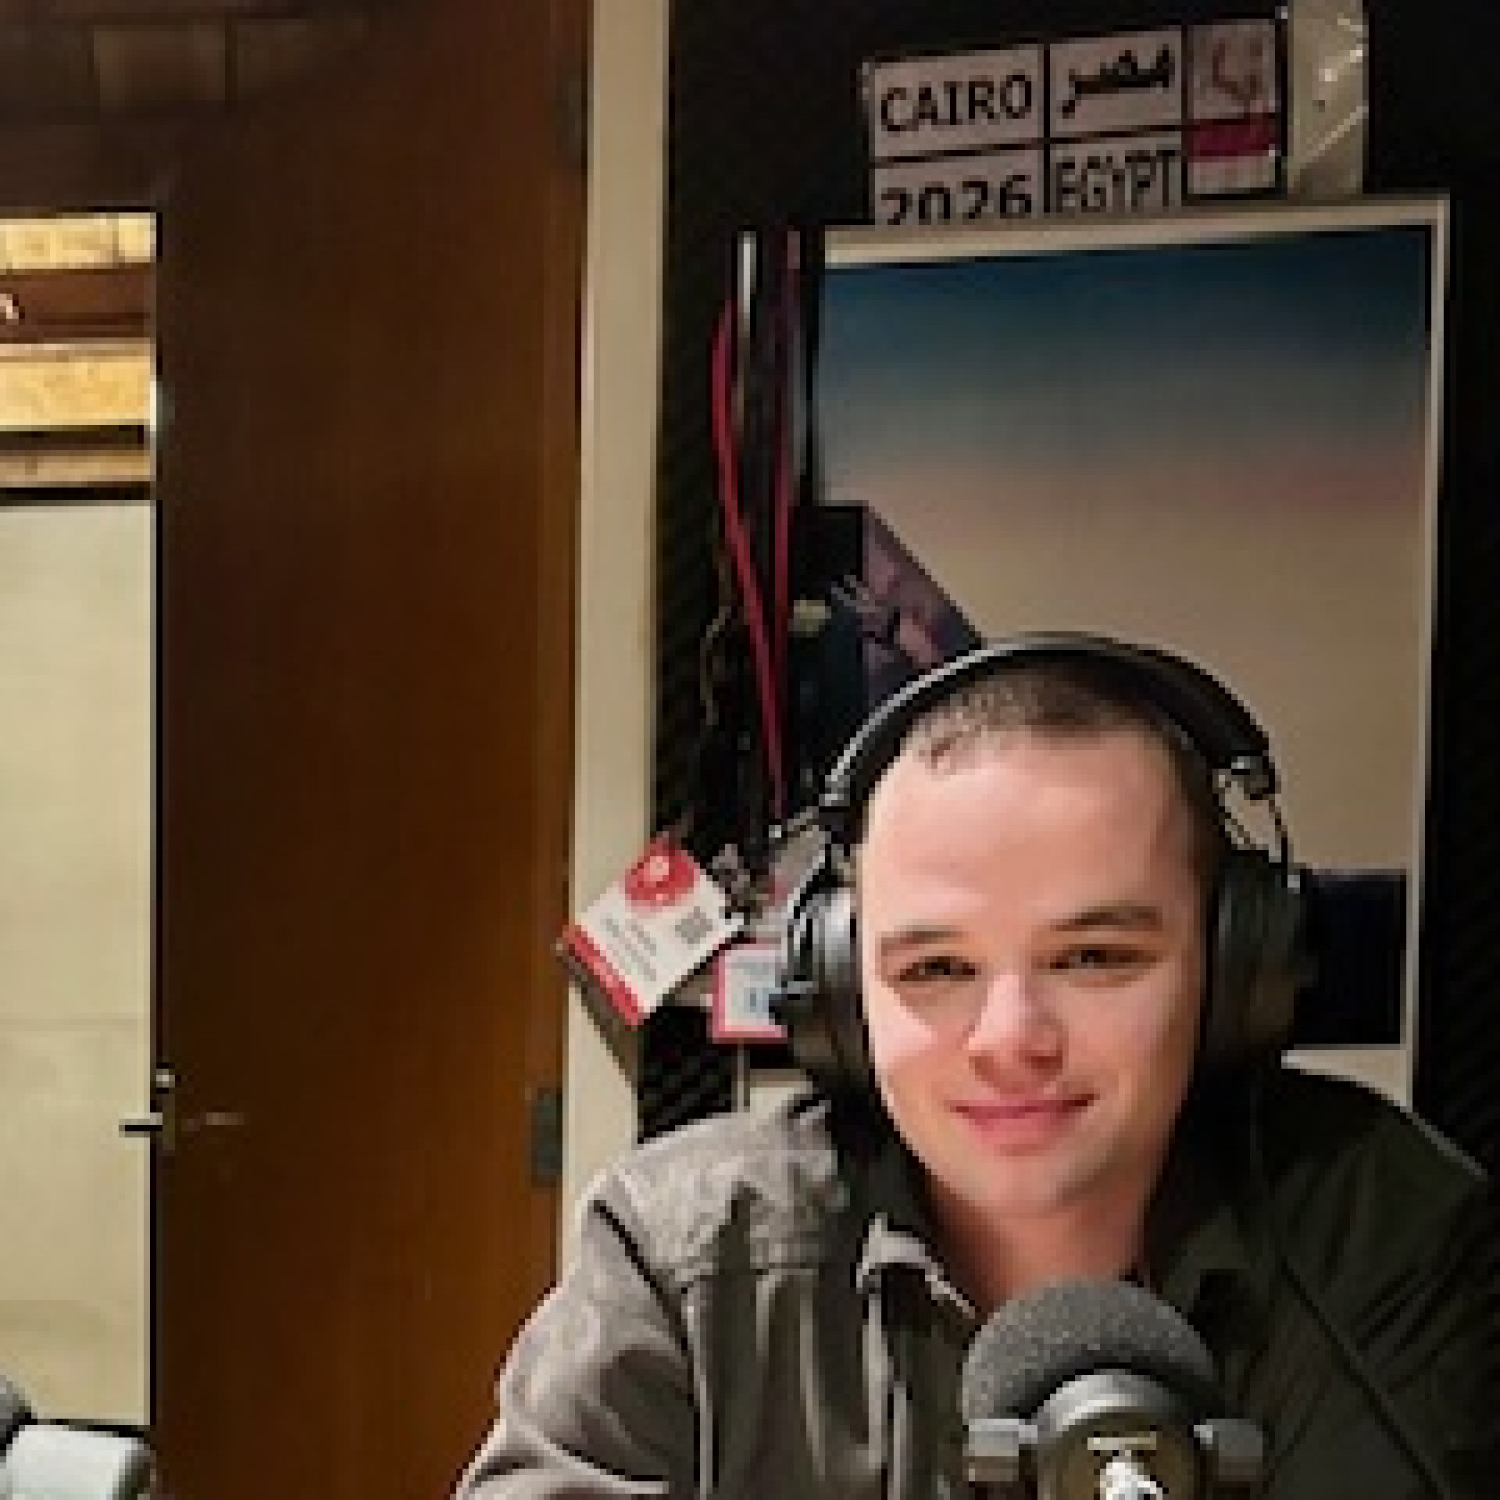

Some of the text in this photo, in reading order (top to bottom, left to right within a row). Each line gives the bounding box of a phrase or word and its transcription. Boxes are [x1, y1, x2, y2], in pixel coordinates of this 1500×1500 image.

[880, 74, 1033, 133] CAIRO
[1062, 46, 1176, 119] مصر
[879, 174, 1034, 226] 2026
[1055, 149, 1179, 214] EGYPT
